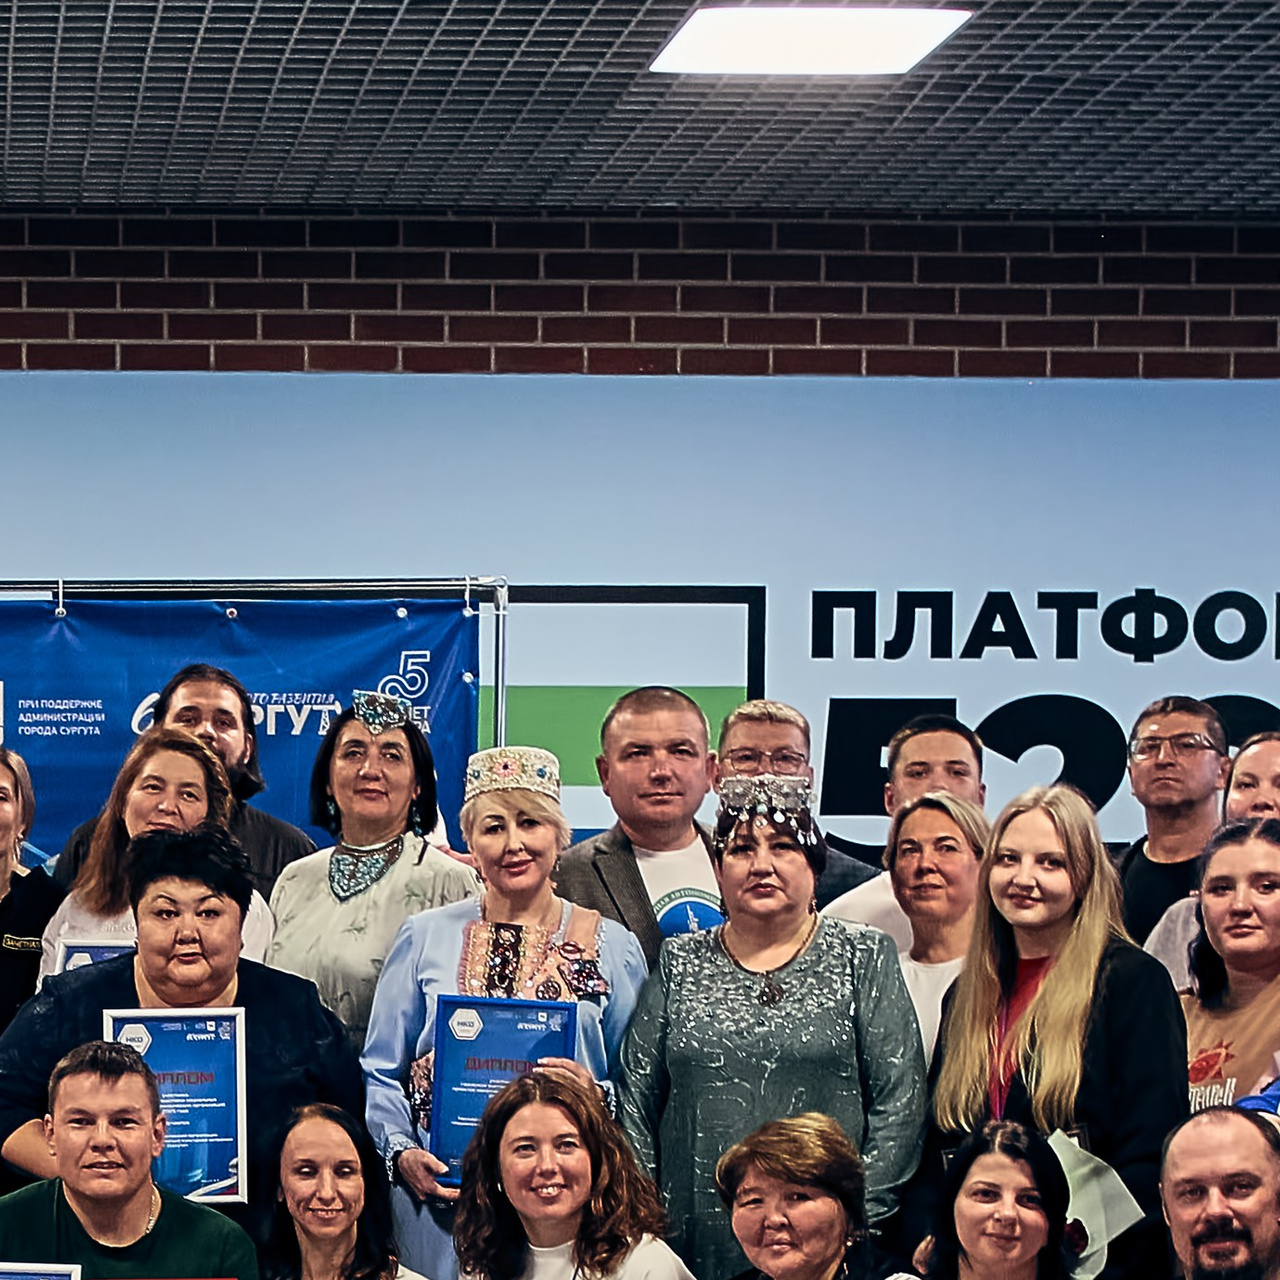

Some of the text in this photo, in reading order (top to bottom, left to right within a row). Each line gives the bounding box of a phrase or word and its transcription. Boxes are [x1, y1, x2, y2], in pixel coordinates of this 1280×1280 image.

[810, 588, 1280, 663] ПЛАТФО
[19, 700, 103, 709] ПРИ ПОДДЕРЖКЕ
[18, 713, 105, 722] АДМИНИСТРАЦИИ
[251, 700, 342, 736] РГУТ
[19, 726, 101, 735] ГОРОДА СУРГУТА
[154, 1071, 215, 1086] ИПЛОМ
